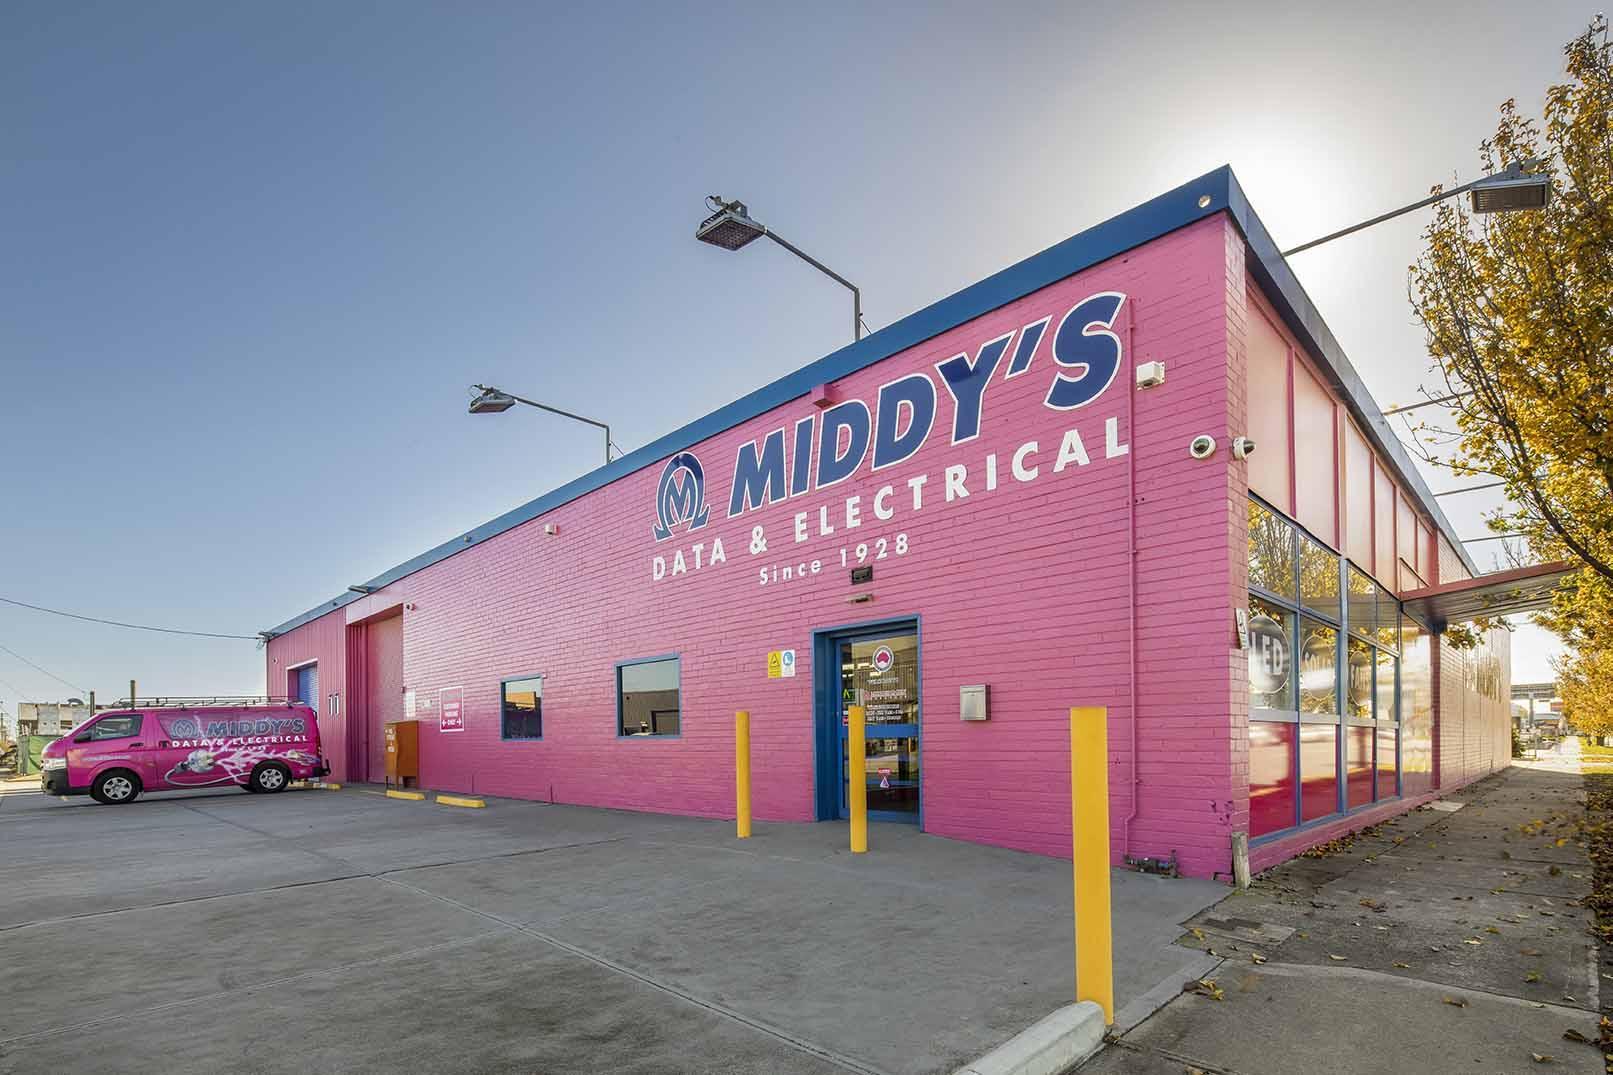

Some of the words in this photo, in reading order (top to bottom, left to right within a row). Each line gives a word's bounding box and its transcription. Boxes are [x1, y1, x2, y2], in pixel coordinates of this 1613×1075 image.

[727, 291, 1127, 519] MIDDY'S
[652, 537, 727, 581] DATA
[749, 524, 767, 555] &
[795, 416, 1130, 543] ELECTRICAL
[759, 555, 822, 586] Since
[840, 533, 909, 568] 1928
[172, 739, 210, 748] DATA
[232, 735, 308, 746] ELECTRICAL
